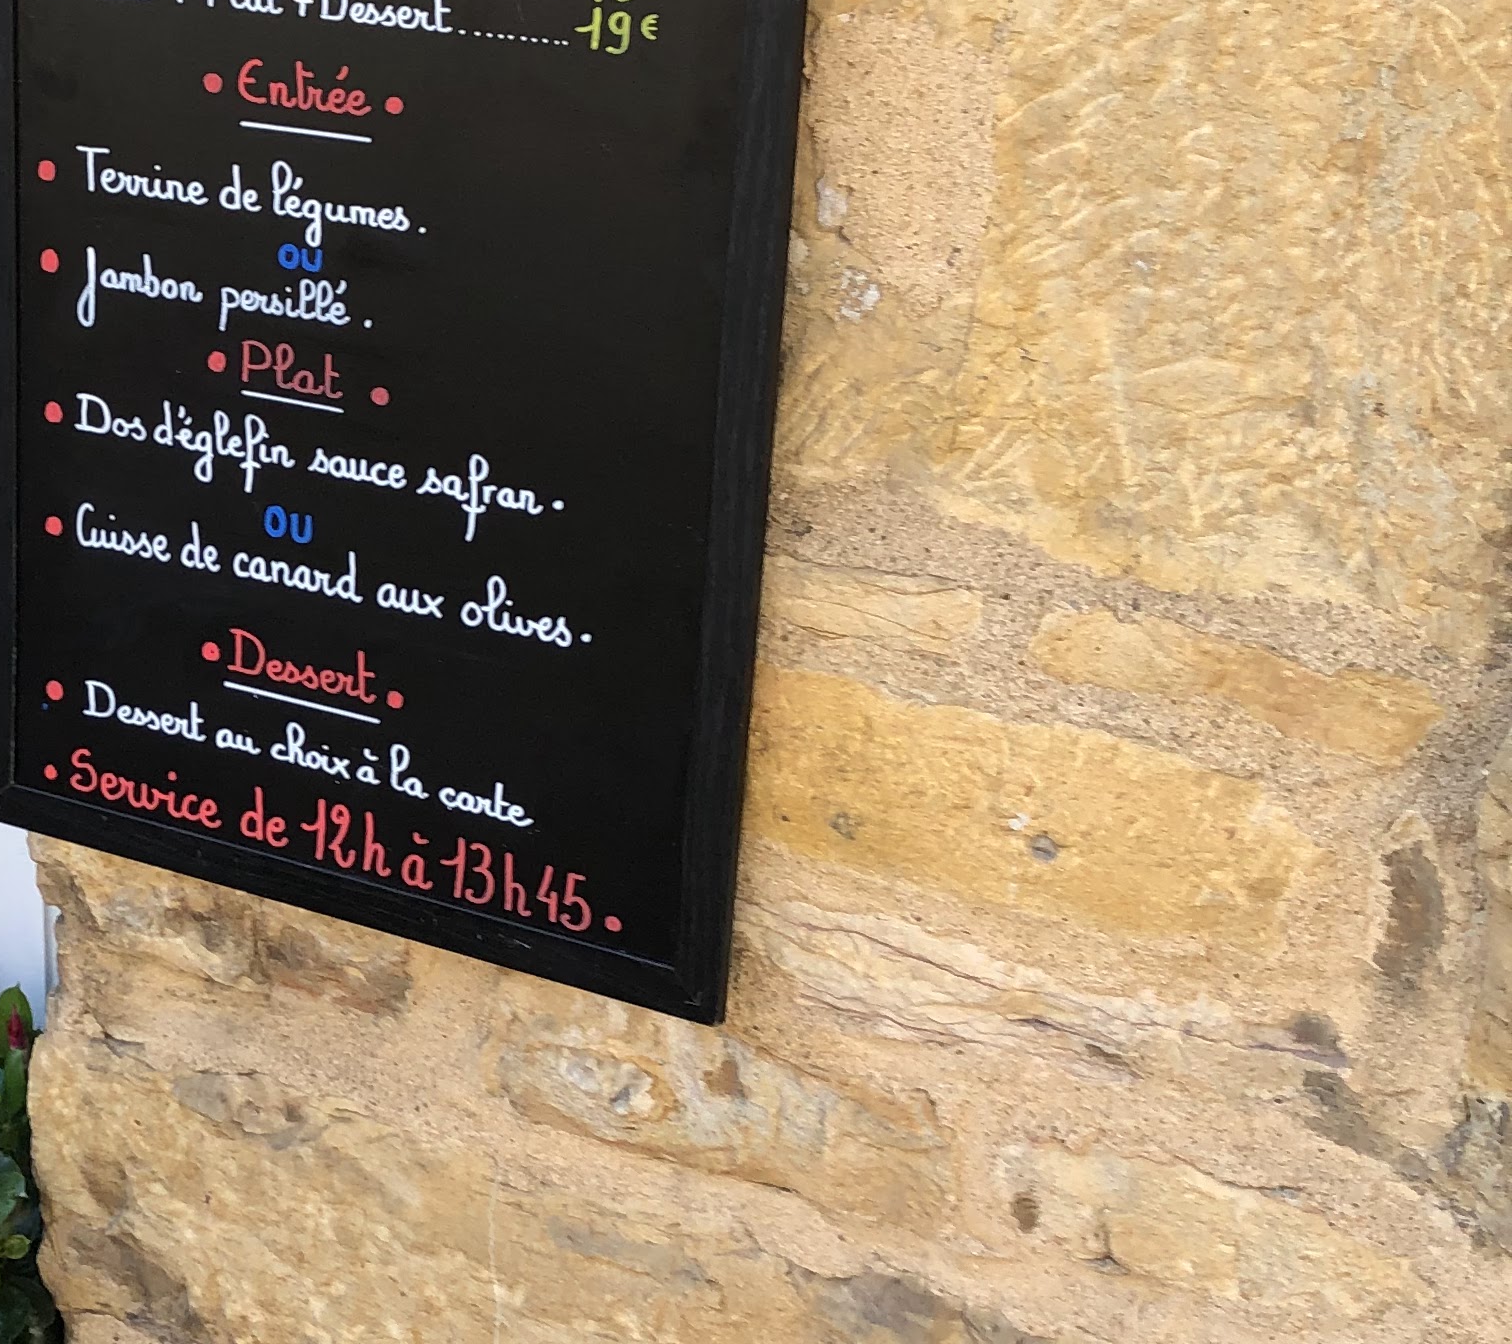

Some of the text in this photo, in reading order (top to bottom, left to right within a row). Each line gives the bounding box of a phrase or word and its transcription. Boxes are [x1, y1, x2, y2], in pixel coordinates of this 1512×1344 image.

[237, 58, 372, 117] Entrée
[75, 145, 210, 205] Terrine
[218, 164, 262, 212] de
[76, 246, 203, 327] Jambon
[240, 340, 344, 400] Plat
[74, 394, 147, 440] Dos
[308, 442, 407, 490] sauce
[75, 502, 172, 556] Cuisse
[180, 526, 222, 572] de
[232, 552, 363, 604] canard
[376, 585, 444, 618] aux
[226, 629, 378, 704] Dessert
[83, 680, 535, 828] Dessert au choix à la carte
[68, 748, 222, 830] Service
[239, 787, 290, 847] de
